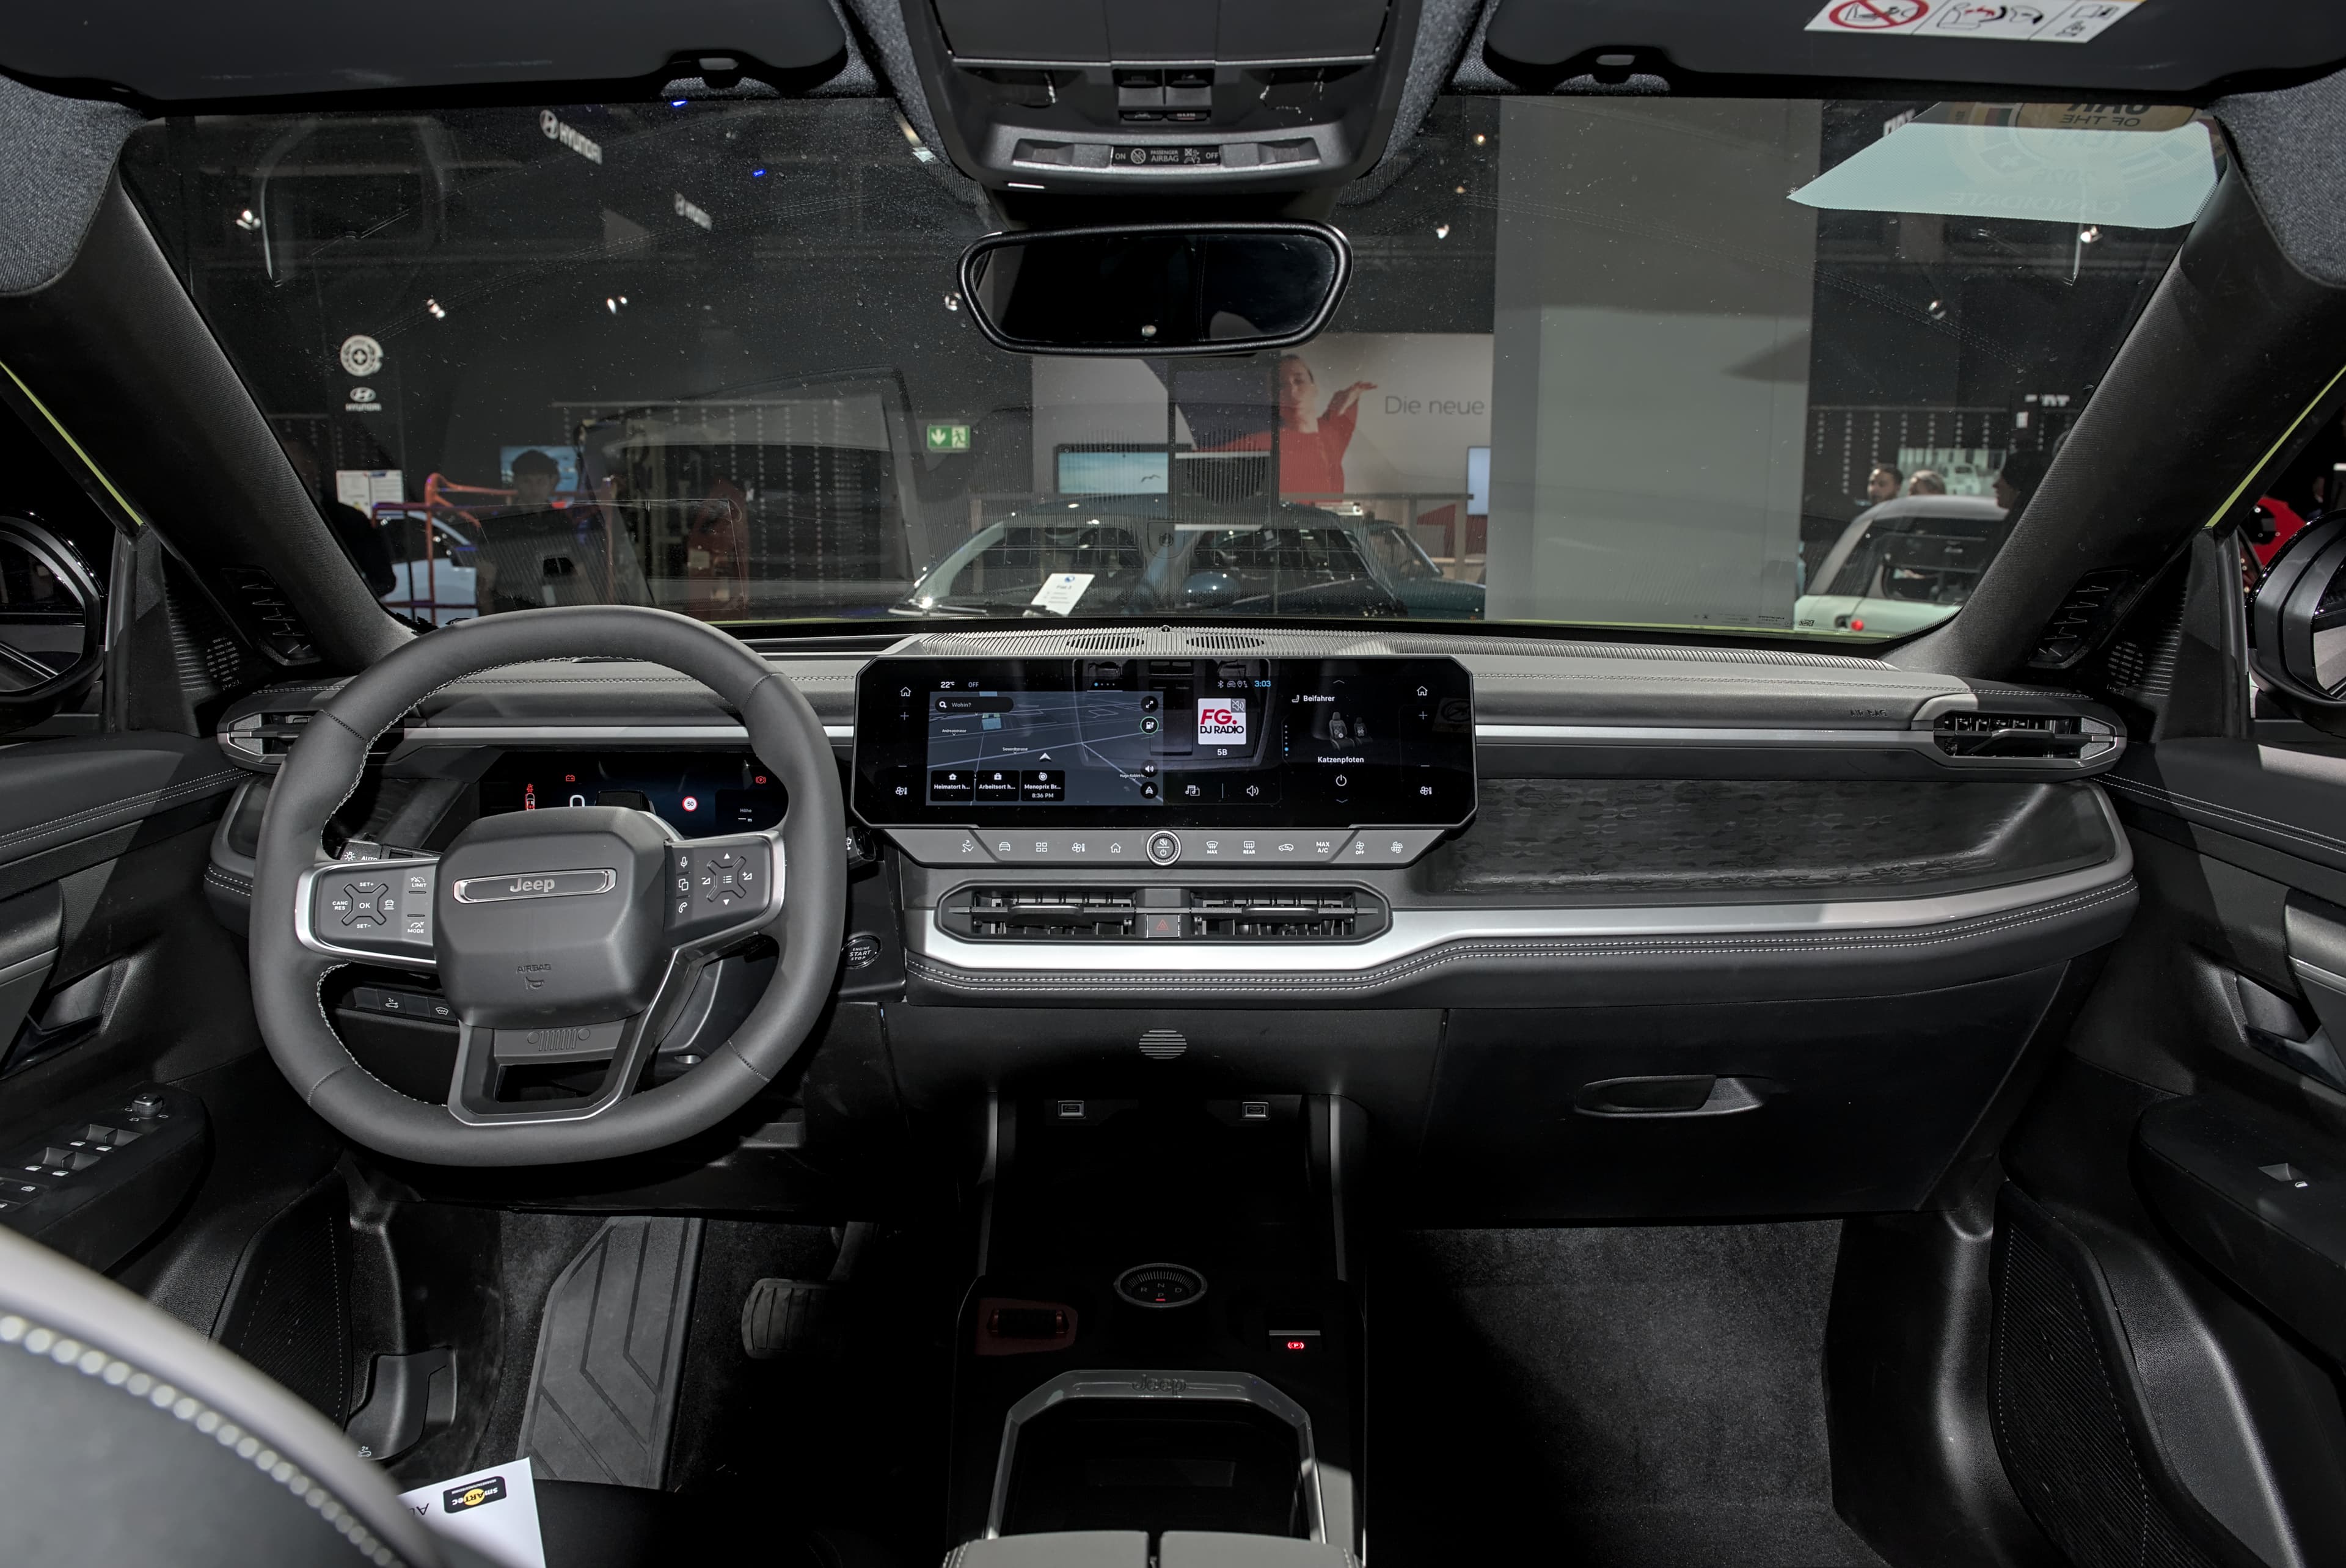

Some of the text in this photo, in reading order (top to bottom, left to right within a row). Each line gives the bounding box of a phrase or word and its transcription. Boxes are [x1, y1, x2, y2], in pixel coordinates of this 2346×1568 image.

[1385, 396, 1485, 415] Die neue
[510, 878, 555, 892] Jeep
[516, 963, 552, 974] AIRBAG
[1131, 1373, 1186, 1395] Jeep
